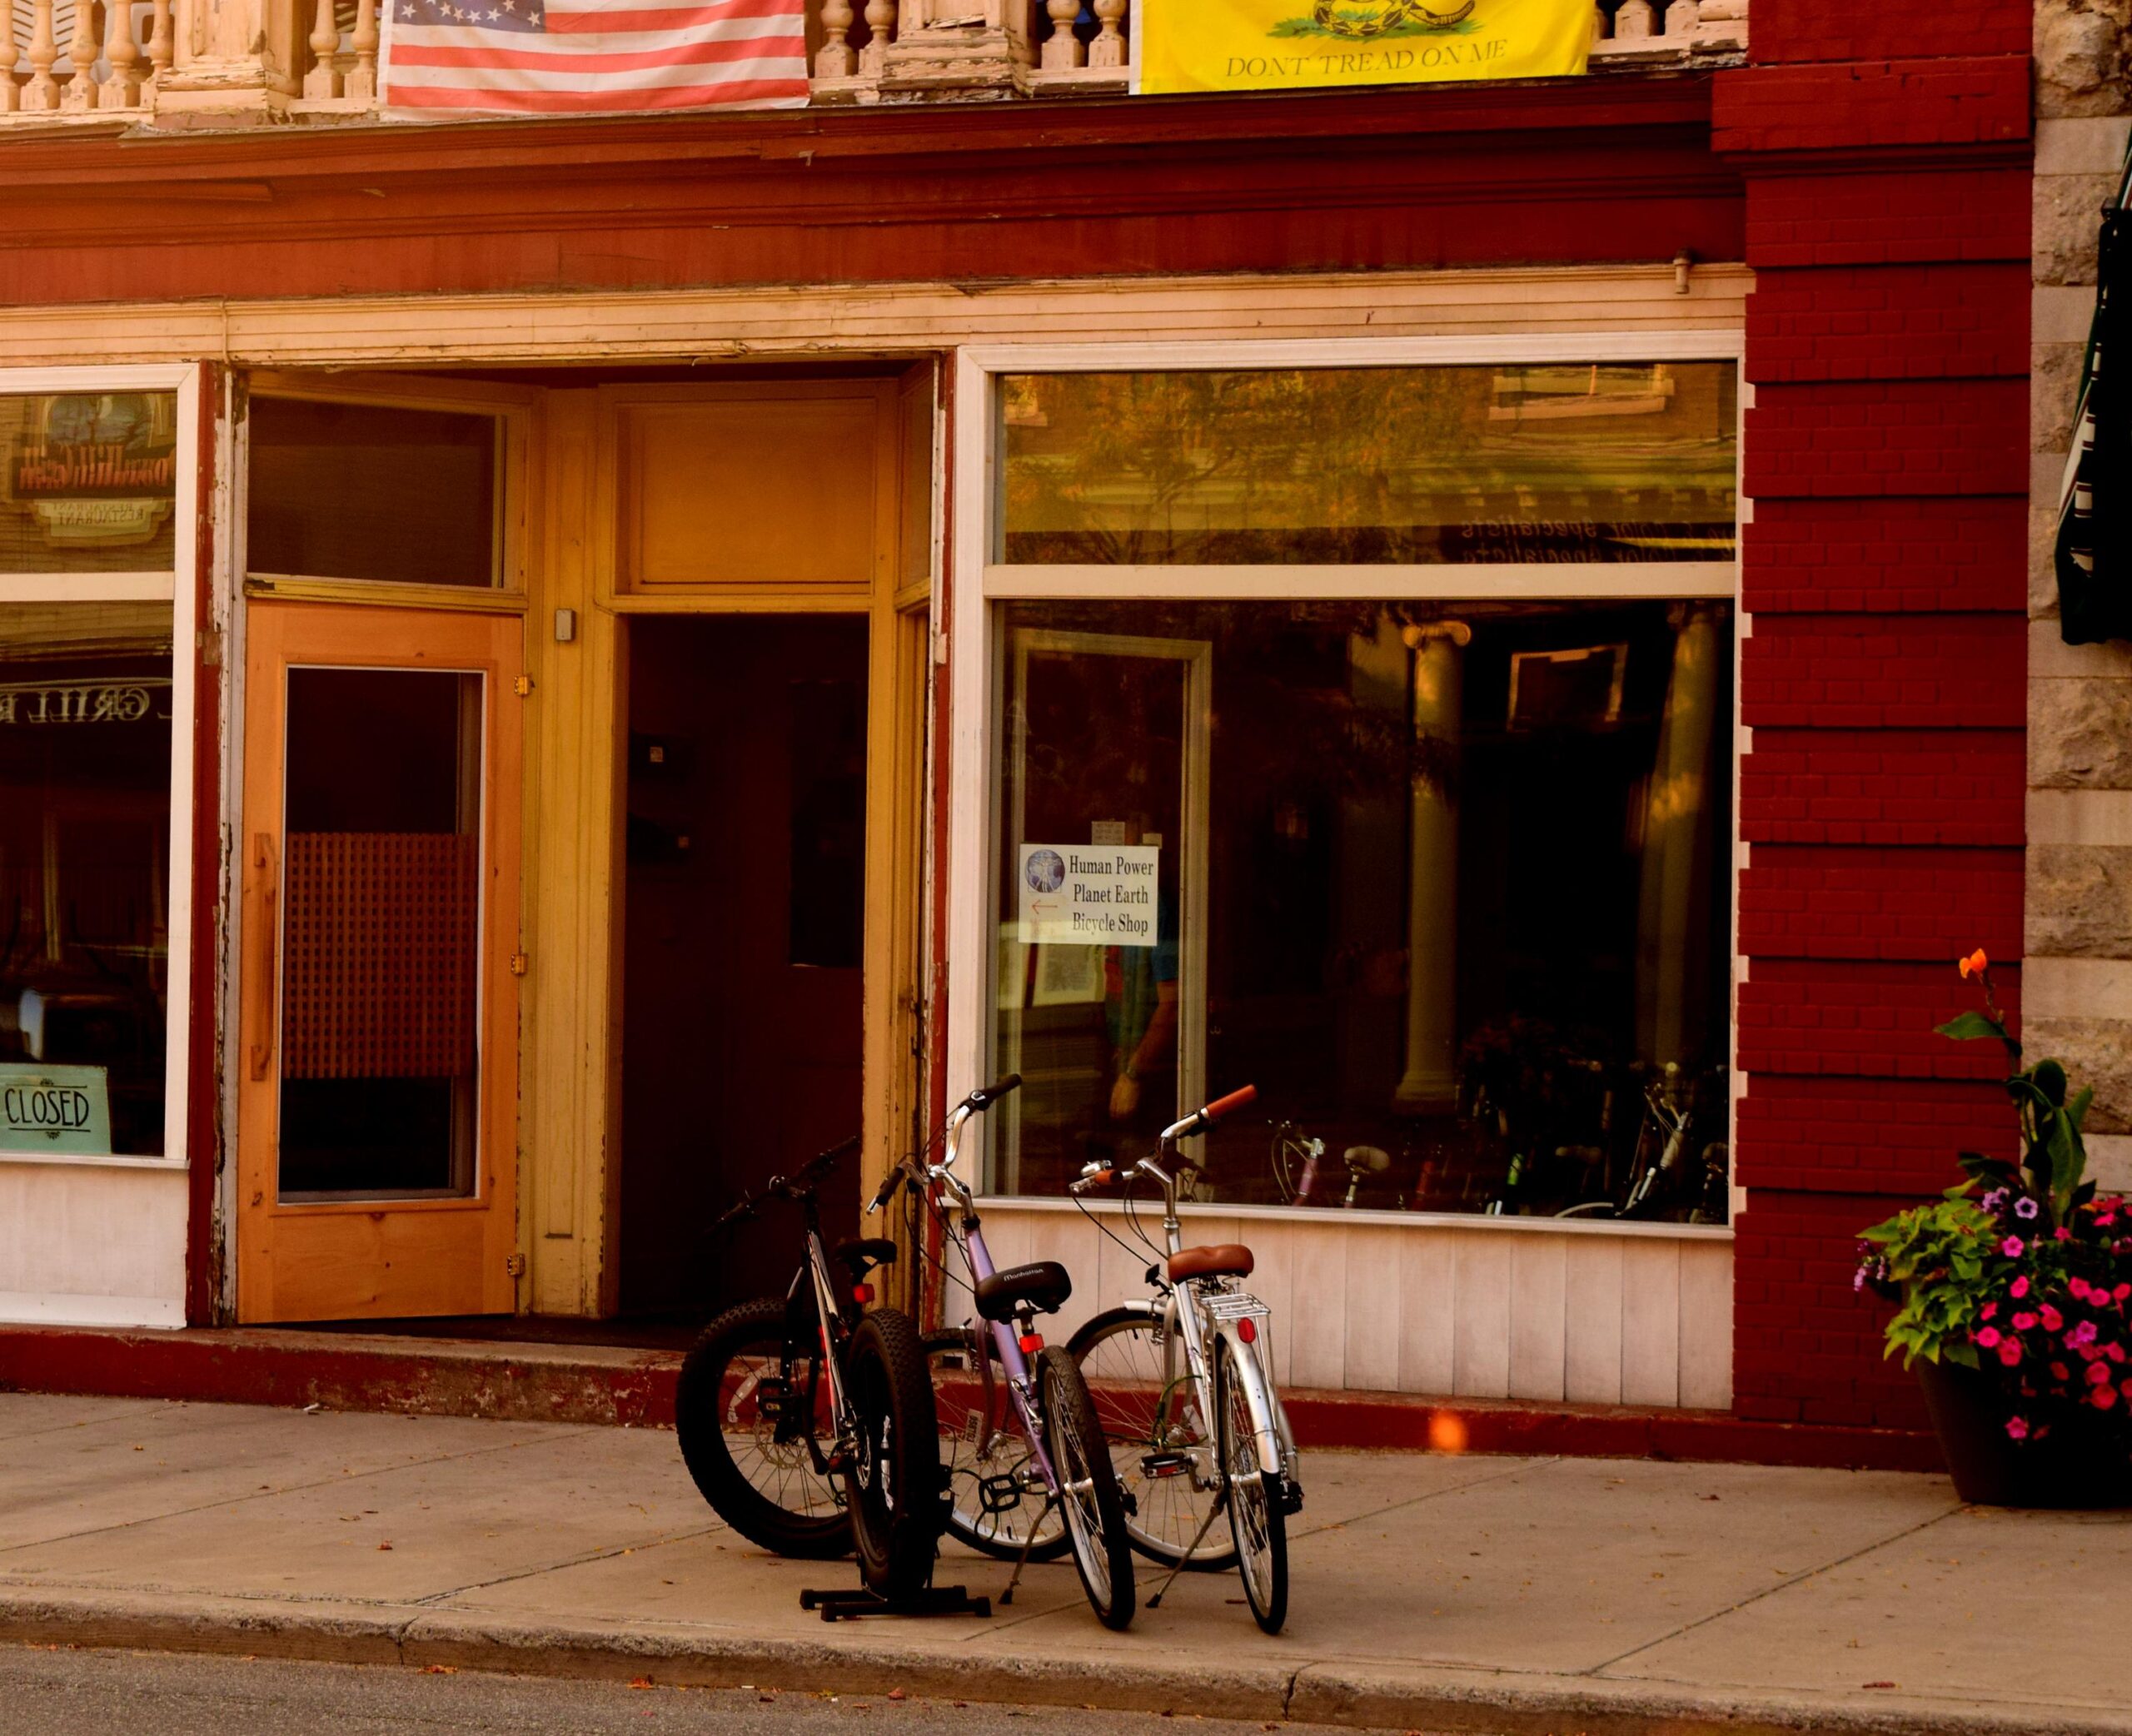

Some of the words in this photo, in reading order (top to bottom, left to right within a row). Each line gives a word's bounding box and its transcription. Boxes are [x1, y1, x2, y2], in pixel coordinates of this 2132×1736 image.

[1226, 57, 1310, 77] DONT
[1318, 50, 1413, 74] TREAD
[1421, 47, 1461, 66] ON
[1467, 39, 1508, 62] ME
[1069, 855, 1112, 875] Human
[1116, 856, 1154, 876] Power
[1073, 883, 1112, 903] Planet
[1115, 885, 1148, 903] Earth
[1073, 913, 1115, 935] Bicycle
[1118, 913, 1148, 936] Shop
[5, 1088, 89, 1127] CLOSED
[1004, 1268, 1044, 1282] Manhattan
